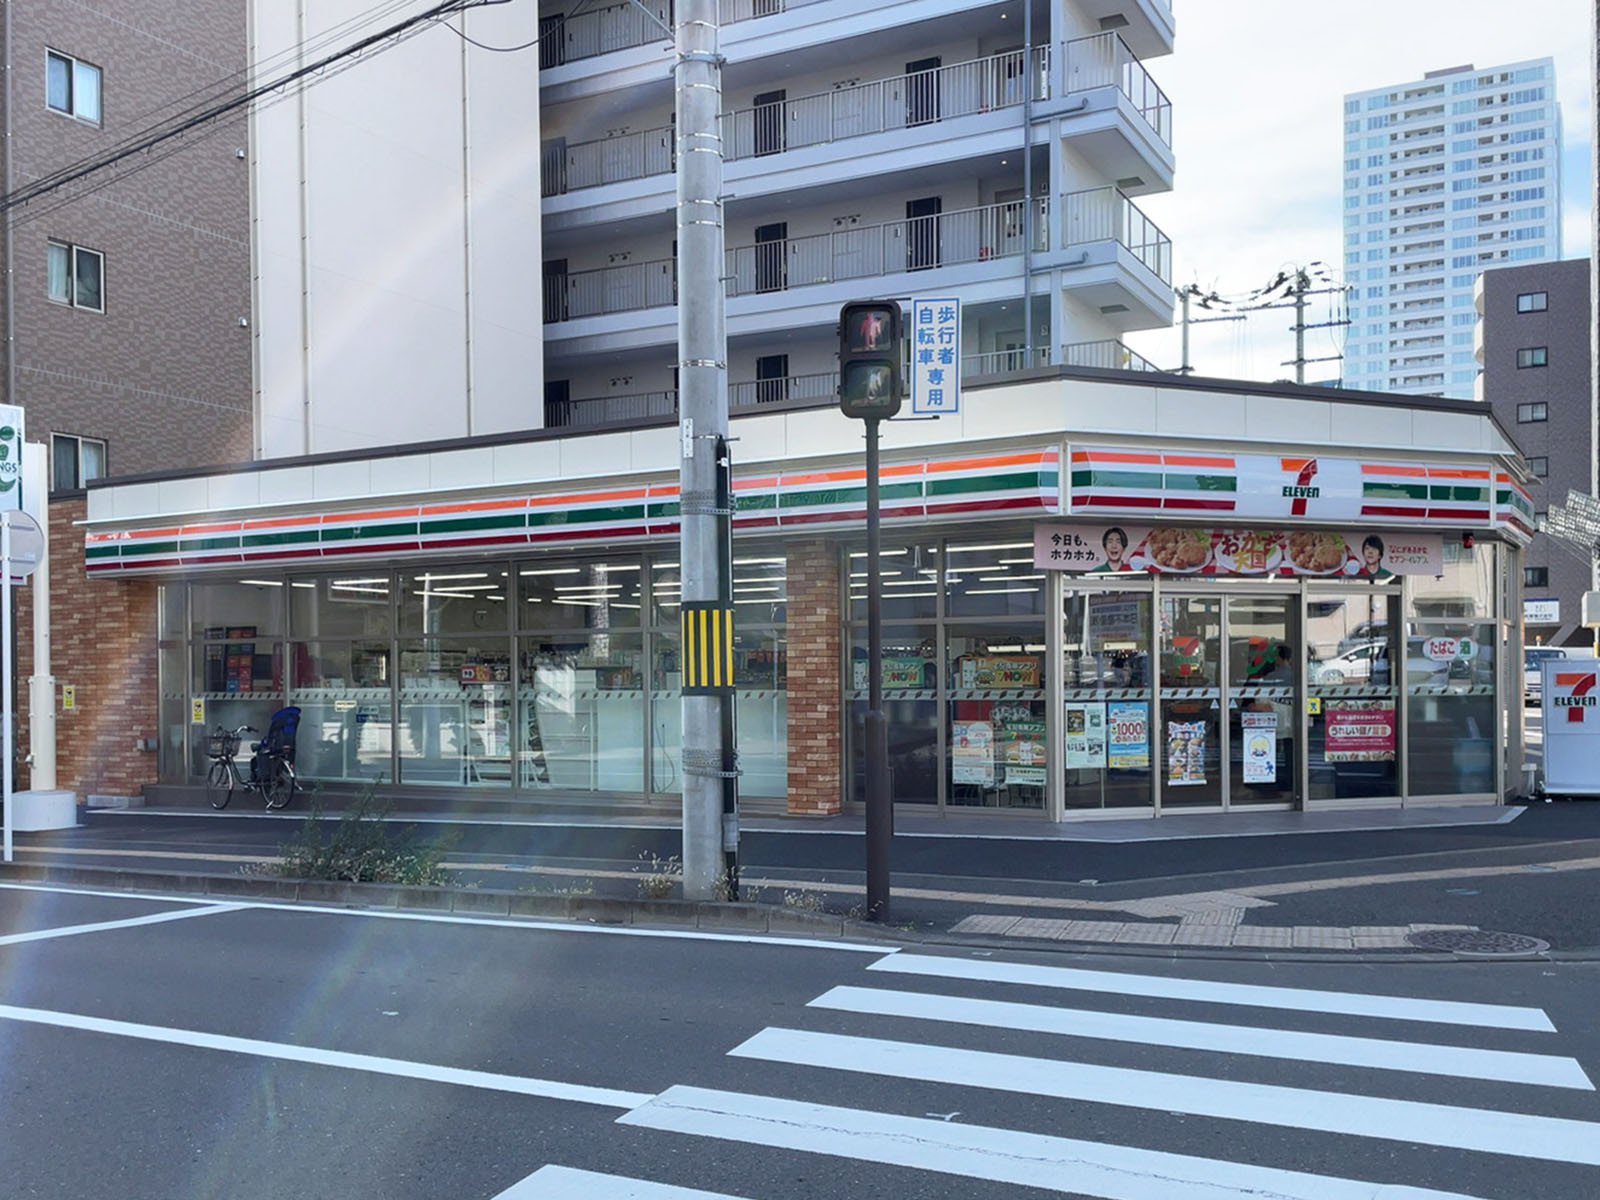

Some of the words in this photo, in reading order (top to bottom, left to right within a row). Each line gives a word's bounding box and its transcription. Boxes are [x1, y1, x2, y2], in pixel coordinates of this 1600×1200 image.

[918, 306, 935, 365] 自転車
[937, 306, 955, 365] 歩行者
[927, 368, 944, 406] 専用
[1282, 486, 1320, 498] ELEVEN
[1051, 533, 1088, 546] 今日も、
[1231, 550, 1267, 571] 天国
[1430, 641, 1455, 654] たばこ
[1460, 641, 1471, 654] 酒
[1555, 696, 1596, 706] ELEVEN
